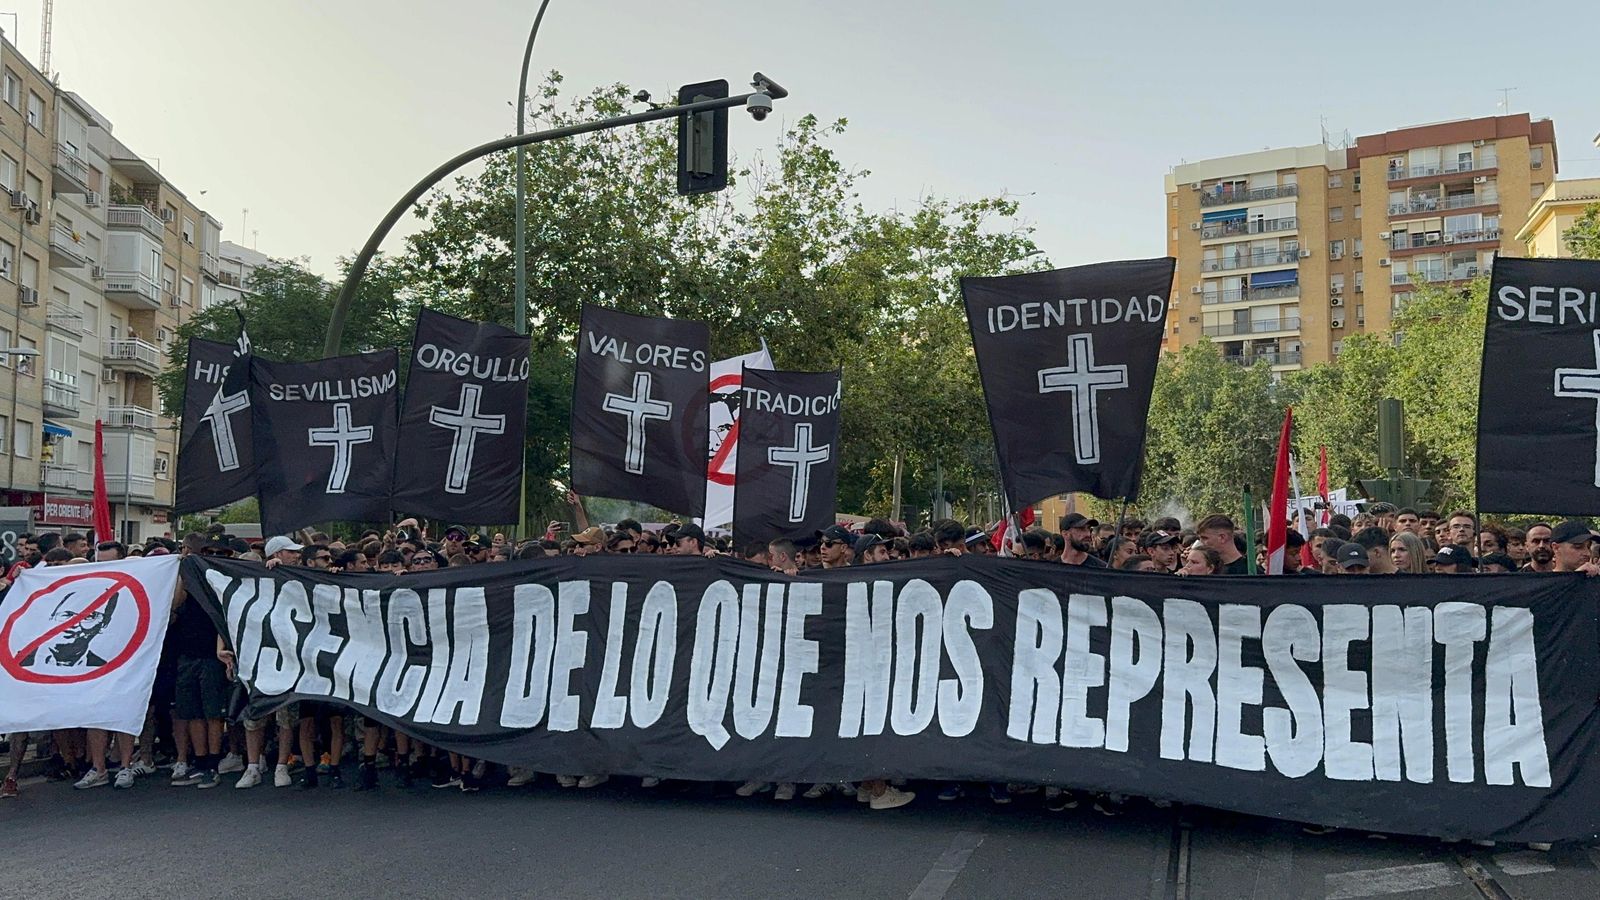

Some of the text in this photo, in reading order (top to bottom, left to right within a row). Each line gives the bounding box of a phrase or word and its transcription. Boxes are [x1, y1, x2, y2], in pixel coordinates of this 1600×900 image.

[987, 295, 1165, 333] IDENTIDAD
[1498, 286, 1597, 324] SERI
[416, 343, 530, 382] ORGULLO
[588, 331, 706, 373] VALORES
[269, 368, 397, 401] SEVILLISMO
[500, 579, 591, 732] DE
[590, 580, 678, 729] LO
[687, 579, 823, 751] QUE
[837, 578, 994, 739] NOS
[1006, 587, 1552, 788] REPRESENTA
